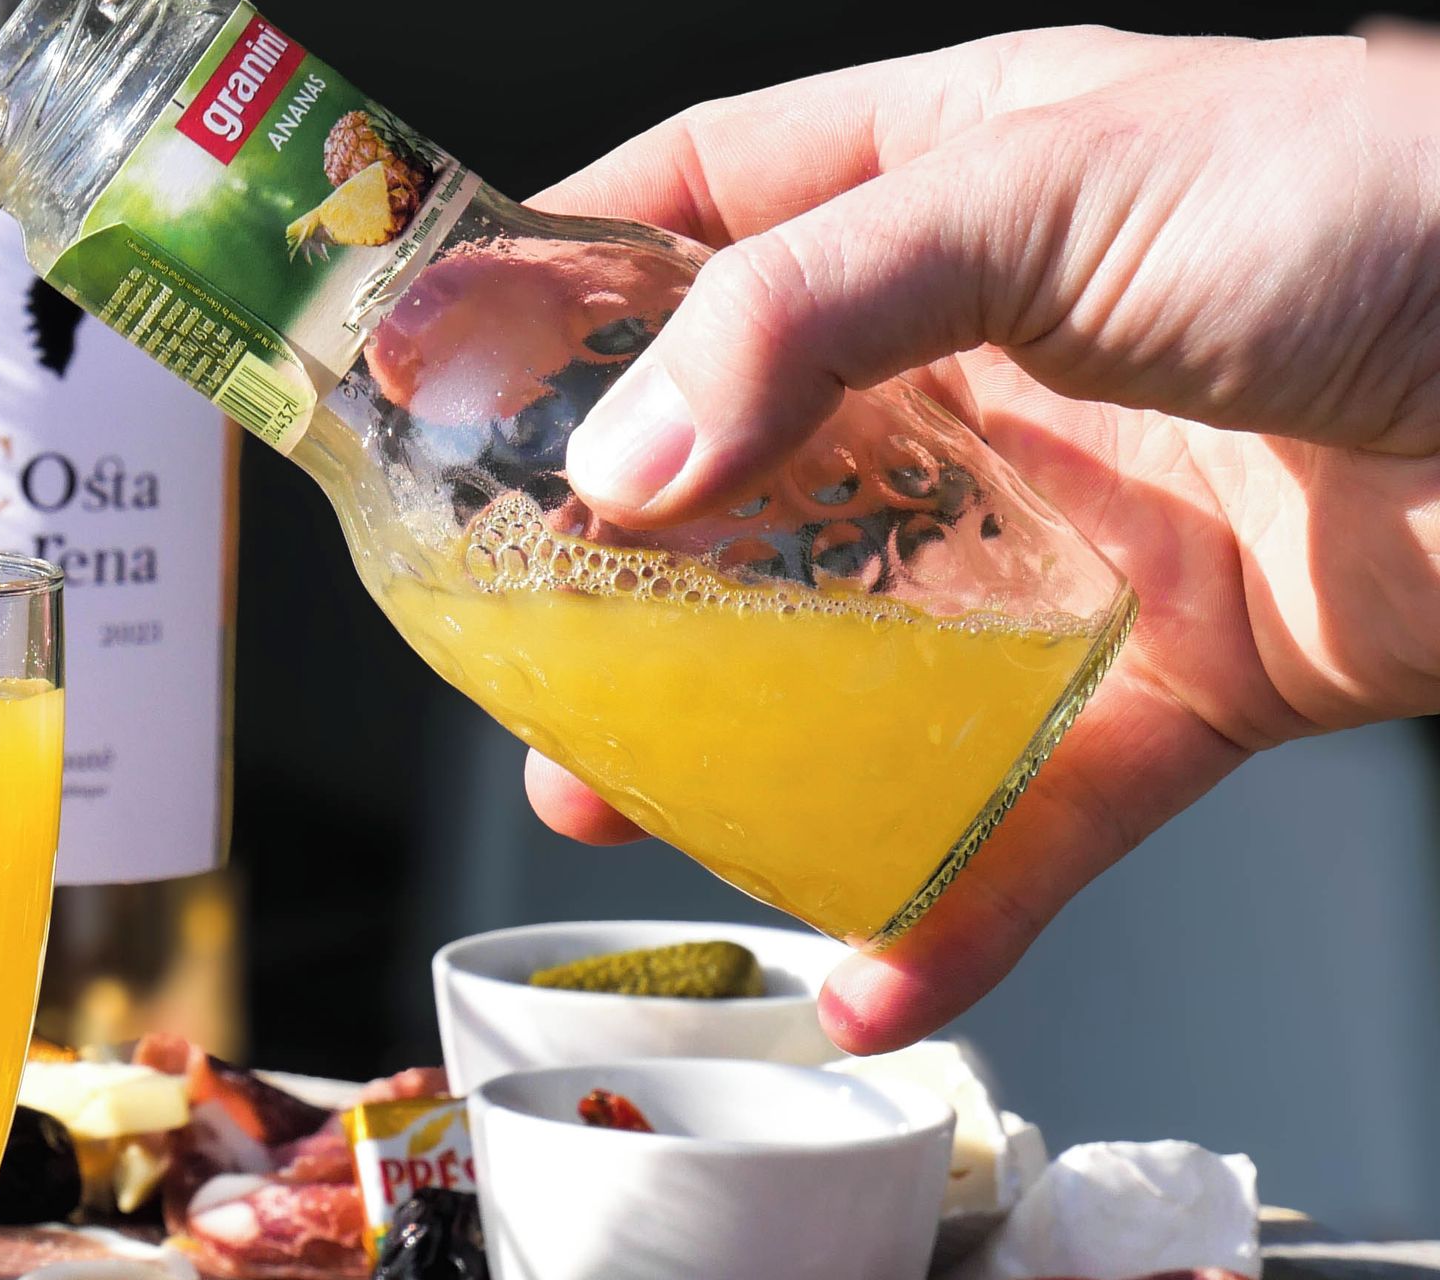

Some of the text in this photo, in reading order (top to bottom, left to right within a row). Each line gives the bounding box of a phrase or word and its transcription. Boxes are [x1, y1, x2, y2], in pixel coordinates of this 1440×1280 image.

[202, 23, 290, 141] granini
[267, 74, 326, 152] ANANAS
[393, 238, 417, 262] 50%
